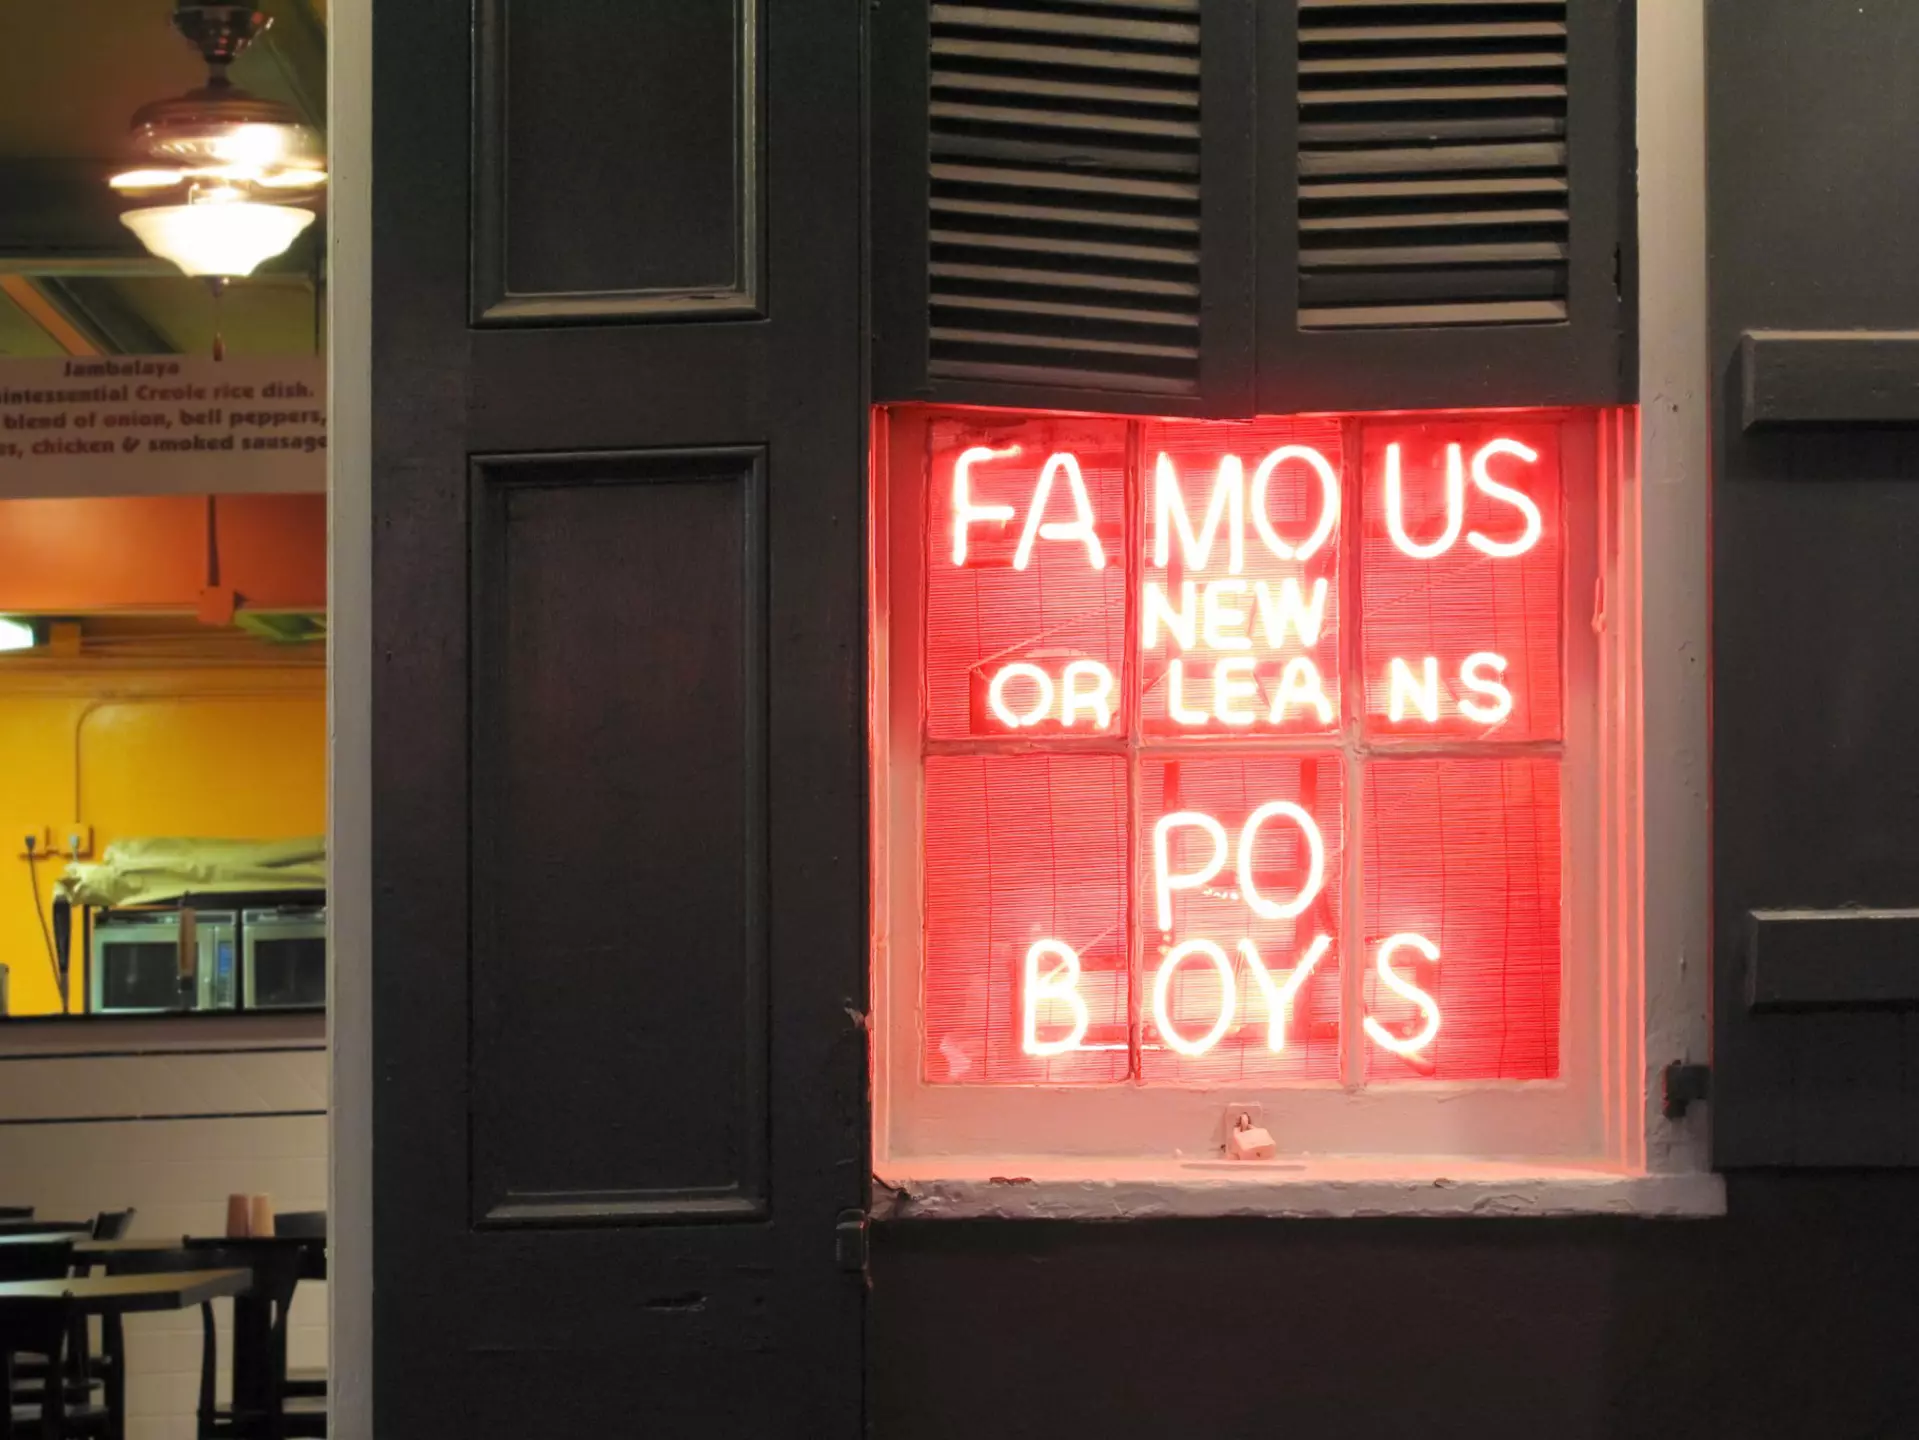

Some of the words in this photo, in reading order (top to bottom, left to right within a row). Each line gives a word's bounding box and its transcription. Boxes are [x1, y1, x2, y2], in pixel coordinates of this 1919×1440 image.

[0, 385, 128, 404] intessential
[135, 383, 206, 401] Creole
[213, 382, 255, 400] rice
[262, 381, 315, 399] dish.
[64, 360, 180, 378] Jambalaya
[4, 411, 66, 430] blend
[74, 411, 96, 428] of
[103, 411, 173, 430] onion,
[180, 408, 222, 426] bell
[230, 409, 327, 431] peppers,
[32, 437, 115, 455] chicken
[122, 436, 140, 453] &
[148, 434, 234, 452] smoked
[950, 437, 1543, 571] FAMOUS
[1141, 577, 1329, 651] NEW
[987, 651, 1513, 730] ORLEANS
[1152, 800, 1325, 932] PO
[1022, 932, 1442, 1058] BOYS
